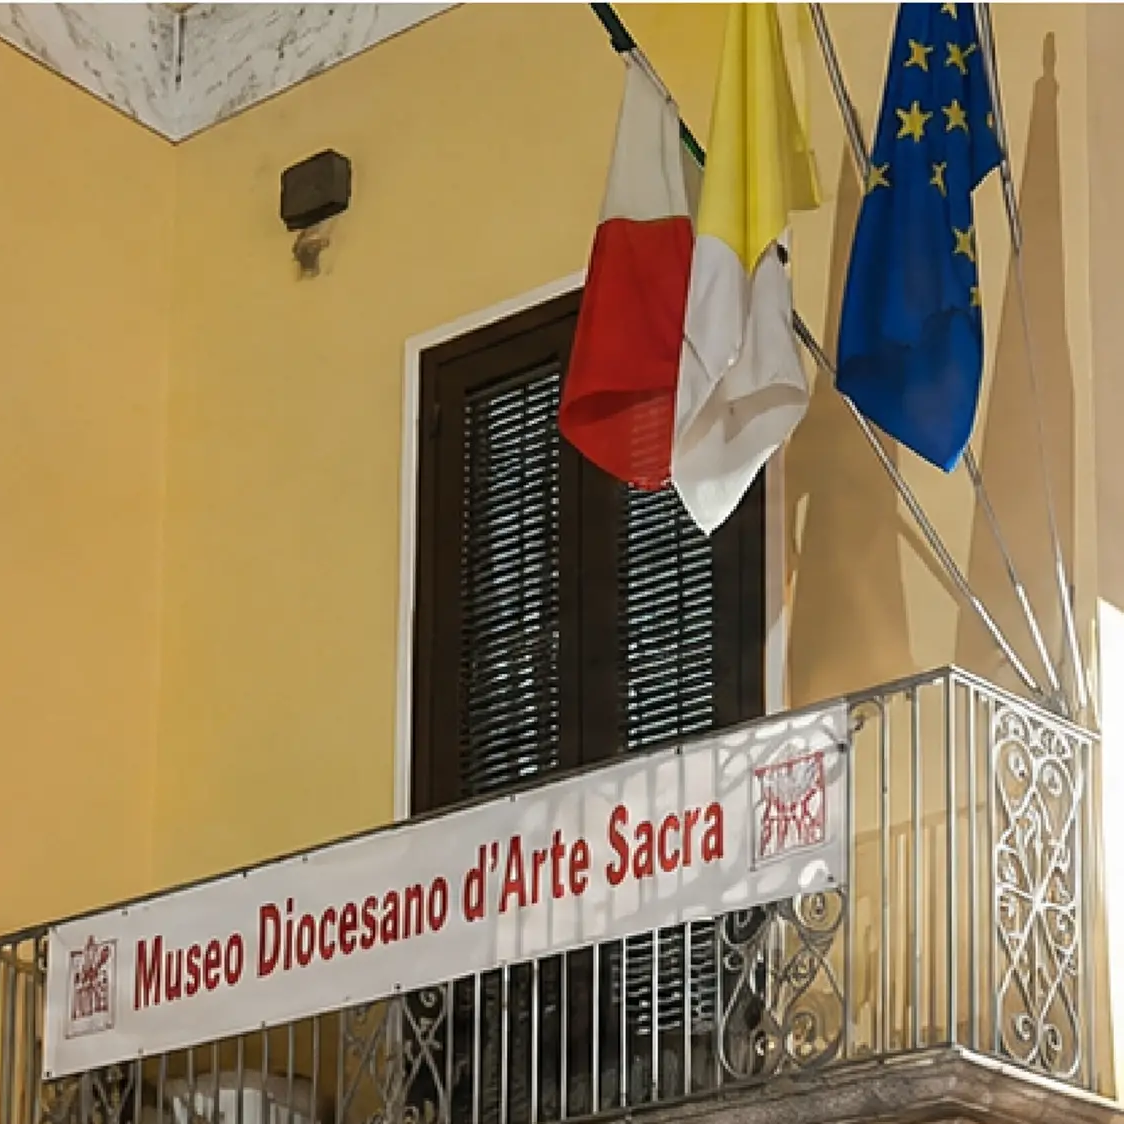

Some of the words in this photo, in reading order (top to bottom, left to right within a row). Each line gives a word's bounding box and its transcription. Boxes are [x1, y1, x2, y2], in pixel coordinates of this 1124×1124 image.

[133, 932, 245, 1010] Museo
[257, 875, 450, 977] Diocesano
[462, 832, 592, 921] d'Arte
[603, 801, 726, 886] Sacra
